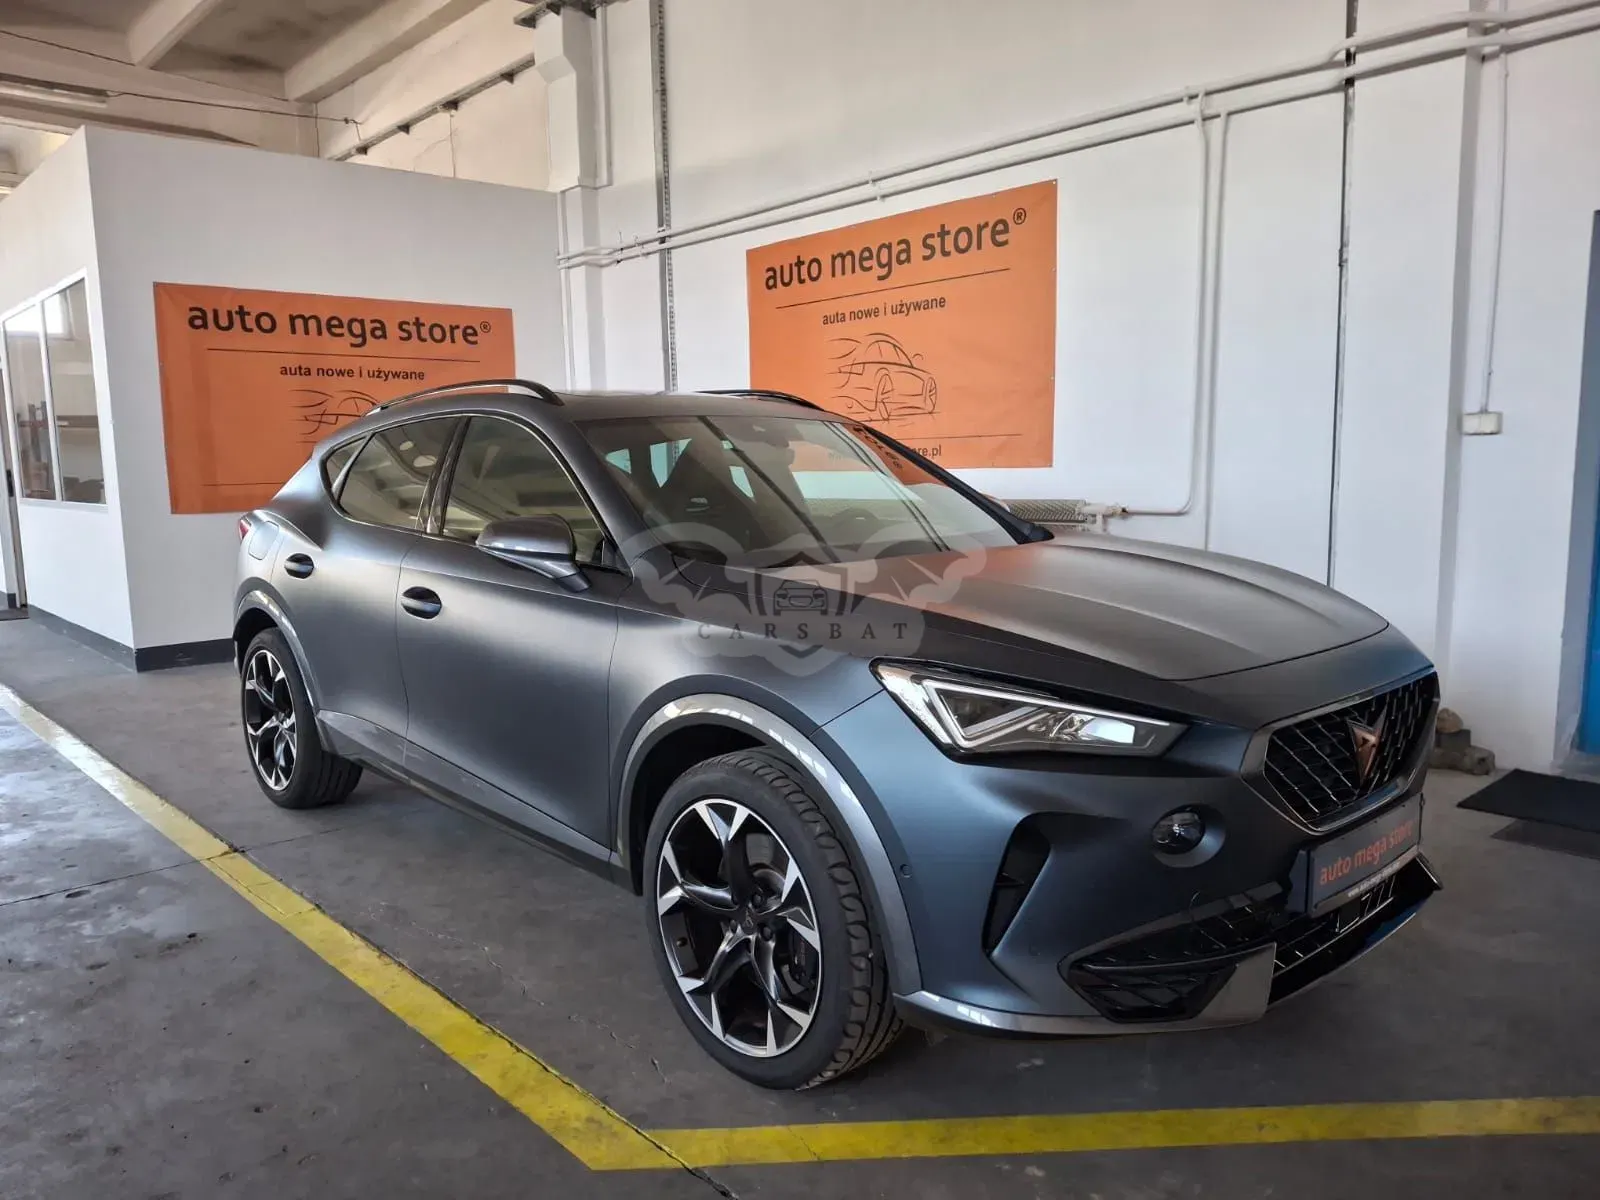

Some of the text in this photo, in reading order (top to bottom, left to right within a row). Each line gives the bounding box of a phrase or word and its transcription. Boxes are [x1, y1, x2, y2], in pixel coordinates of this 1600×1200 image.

[765, 254, 822, 290] auto
[831, 238, 912, 280] mega
[187, 304, 278, 333] auto
[288, 312, 387, 348] mega
[821, 310, 846, 326] auta
[849, 307, 879, 323] nowe
[891, 296, 946, 316] używane
[280, 364, 312, 378] auta
[317, 367, 354, 379] nowe
[367, 368, 425, 382] używane
[1320, 856, 1352, 884] auto
[1354, 838, 1387, 867] mega
